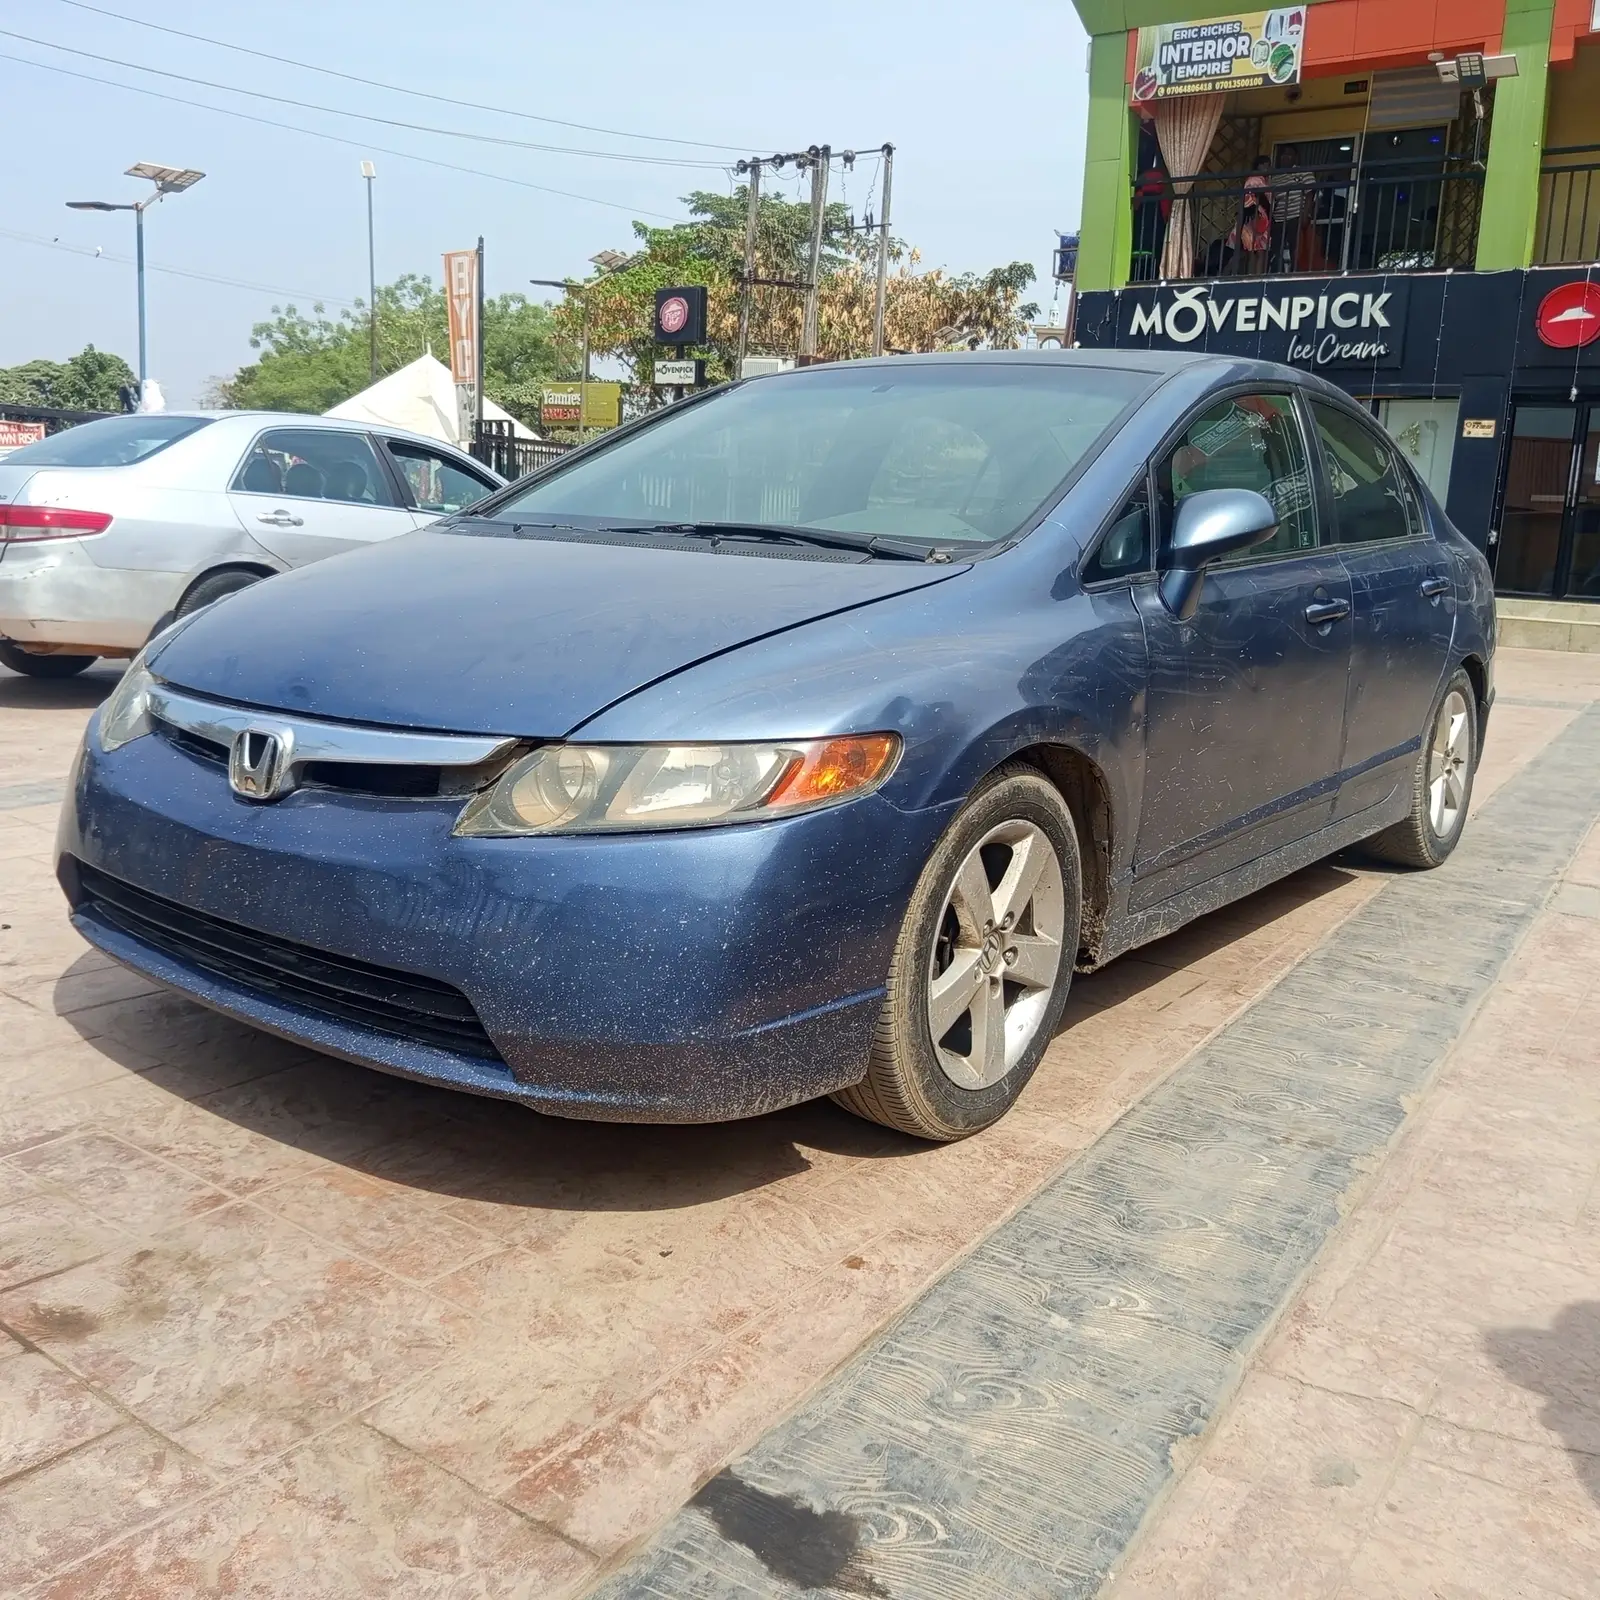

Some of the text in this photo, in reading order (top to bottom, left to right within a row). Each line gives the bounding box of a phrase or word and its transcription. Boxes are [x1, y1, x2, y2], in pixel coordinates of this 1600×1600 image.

[1173, 27, 1199, 40] ERIC
[1200, 22, 1241, 38] RICHES
[1161, 36, 1250, 65] INTERIOR
[1177, 61, 1231, 78] EMPIRE
[1286, 333, 1389, 365] Ice Cream
[542, 387, 581, 406] Yannies
[18, 432, 38, 444] RISK
